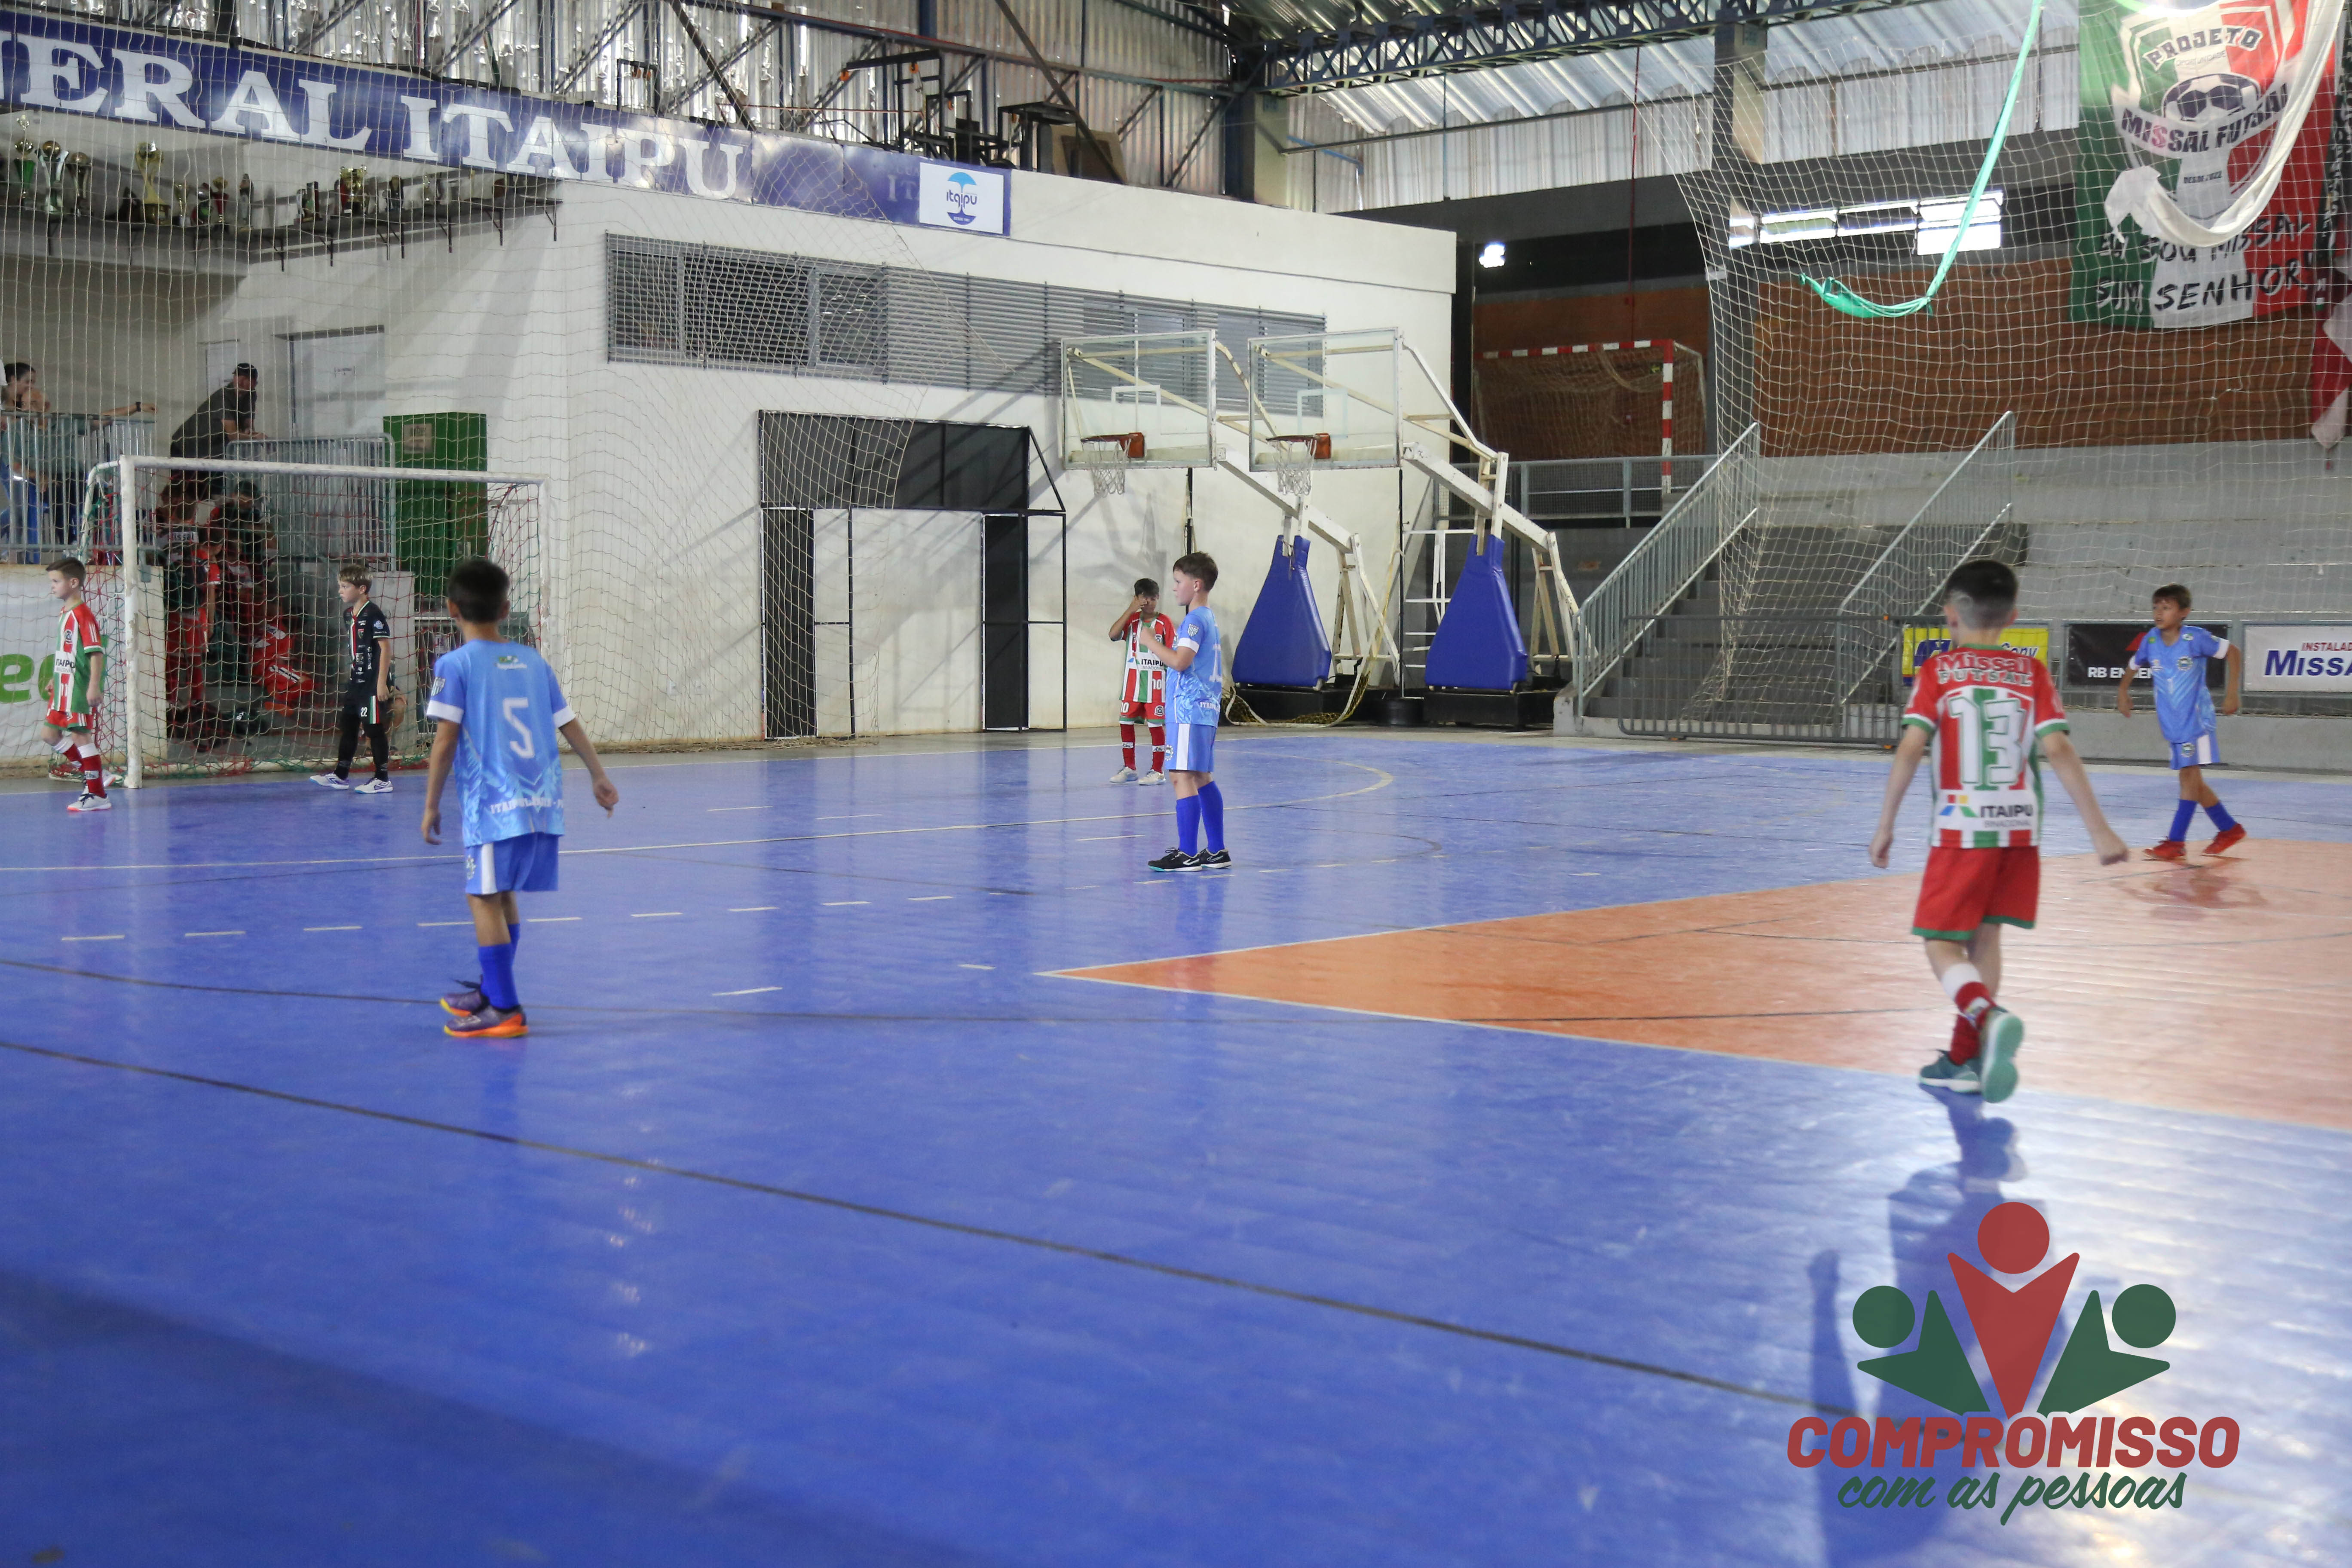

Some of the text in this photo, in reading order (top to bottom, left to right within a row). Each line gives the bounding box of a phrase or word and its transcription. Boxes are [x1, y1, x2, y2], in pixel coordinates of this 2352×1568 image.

[2144, 26, 2262, 68] PROJETO
[0, 30, 744, 202] ERAL ITAIPU
[2122, 107, 2209, 153] MISSAL
[946, 189, 977, 209] itaipu
[2096, 257, 2308, 315] SIM SENHOR
[1141, 658, 1164, 667] ITAIPU
[1935, 652, 2032, 674] Missal
[2087, 667, 2107, 678] RB
[1152, 678, 1162, 690] 10
[1938, 668, 2034, 686] FUTSAL
[360, 707, 368, 717] 22
[502, 697, 535, 759] 5
[1948, 696, 2026, 786] 13
[1980, 805, 2033, 818] ITAIPU
